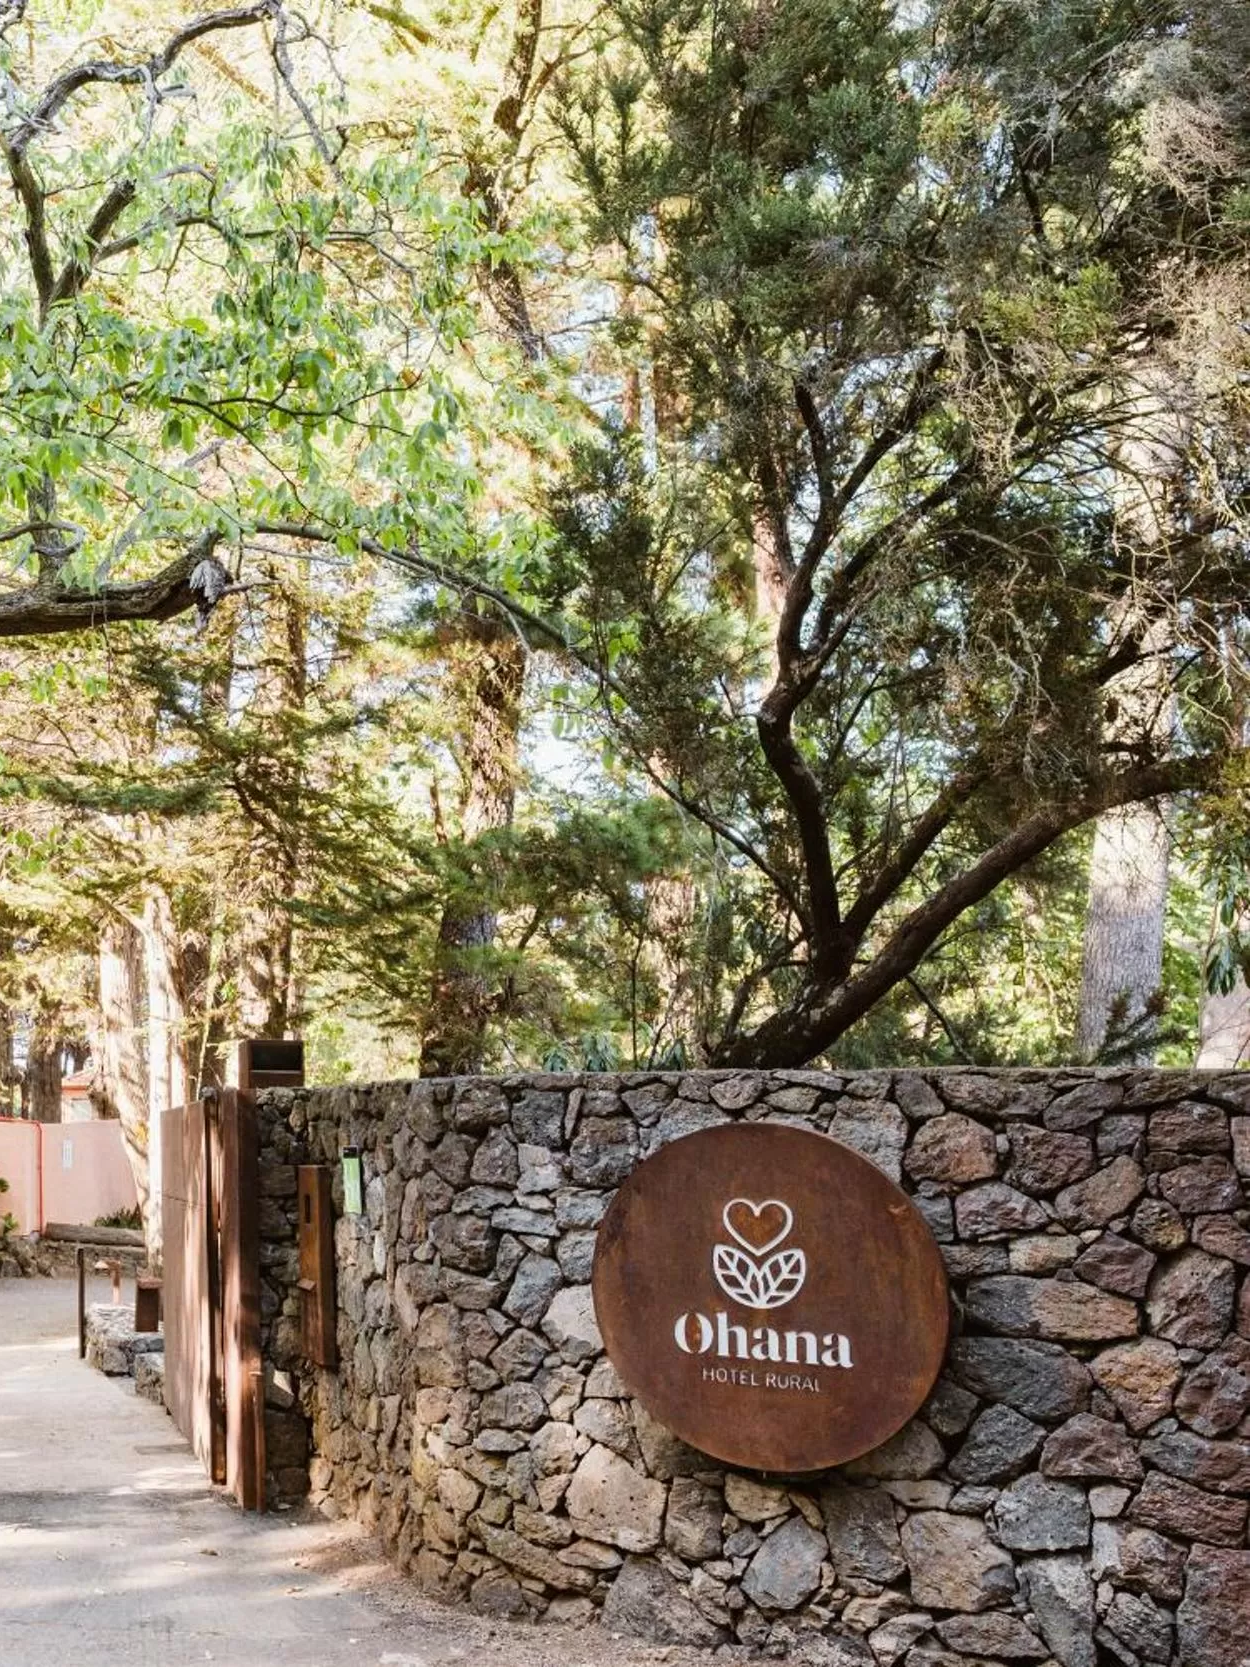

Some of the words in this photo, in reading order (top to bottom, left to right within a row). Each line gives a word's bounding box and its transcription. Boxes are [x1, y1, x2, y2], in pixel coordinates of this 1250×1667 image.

[674, 1311, 855, 1369] Ohana
[702, 1367, 760, 1387] HOTEL
[765, 1372, 821, 1393] RURAL
